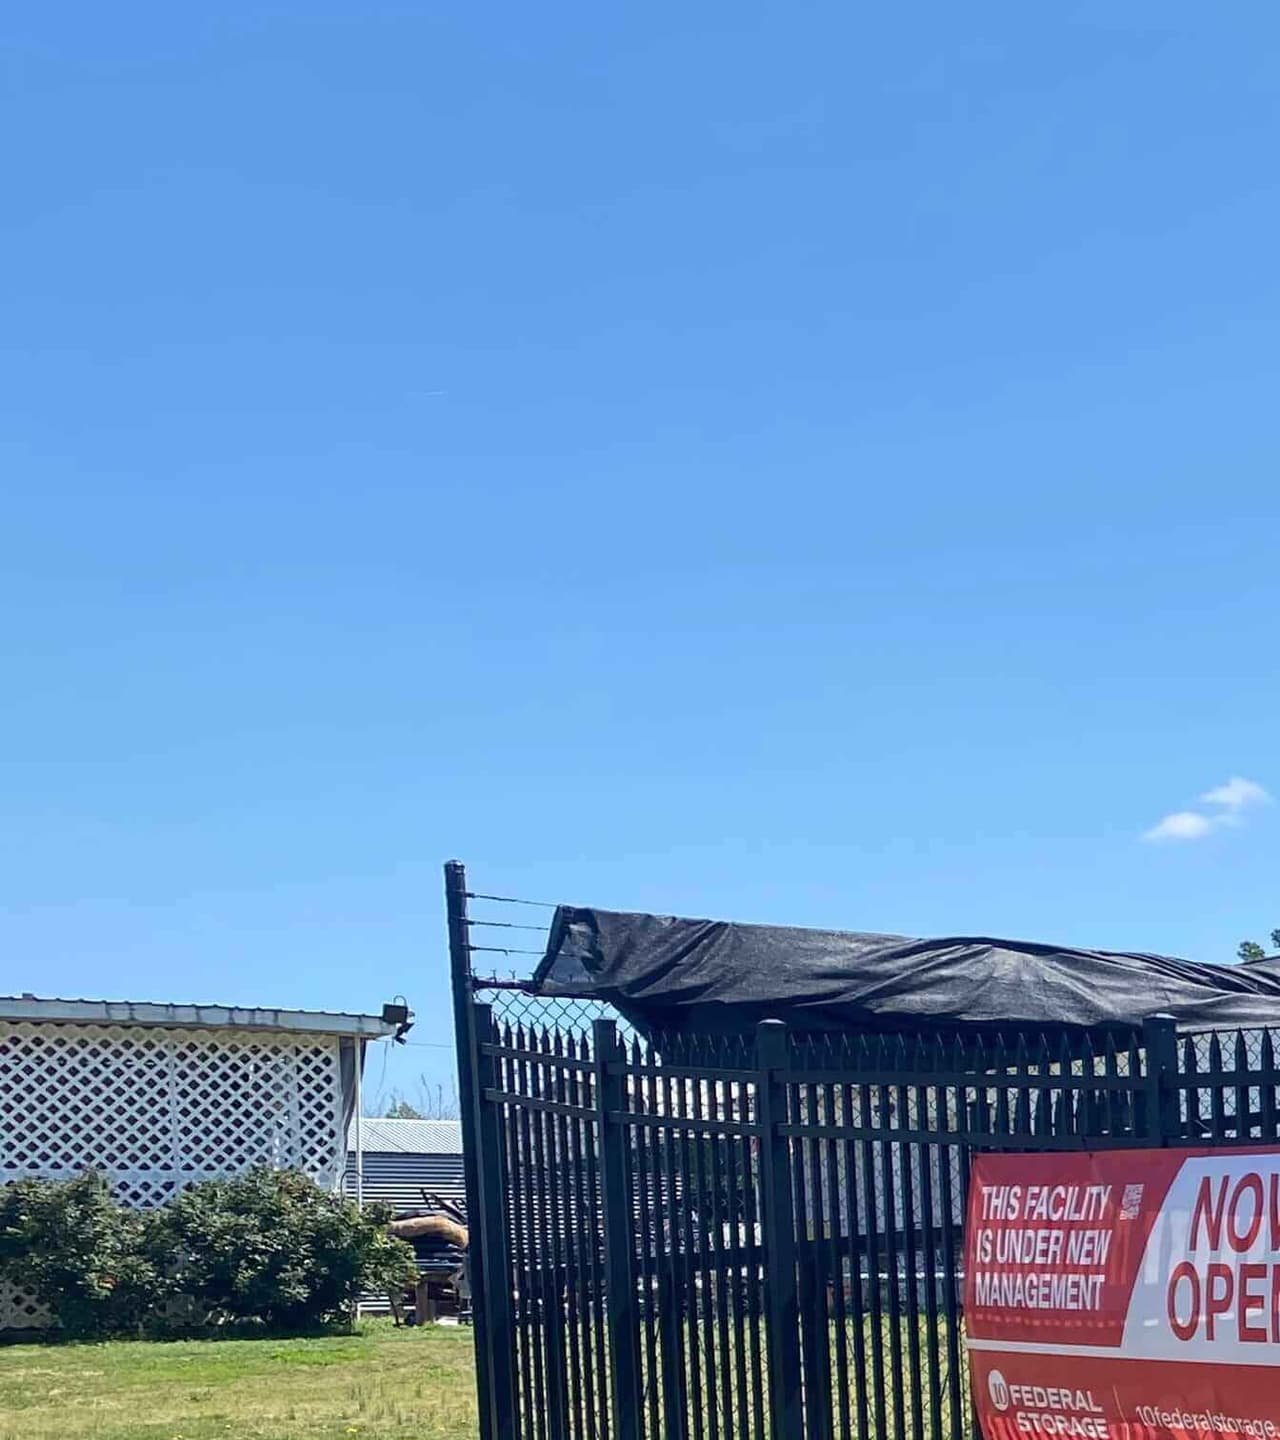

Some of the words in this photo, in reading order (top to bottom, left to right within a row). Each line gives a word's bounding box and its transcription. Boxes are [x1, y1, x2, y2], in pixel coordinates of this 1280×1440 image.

[980, 1186, 1020, 1221] THIS
[1022, 1184, 1112, 1221] FACILITY
[975, 1229, 991, 1264] IS
[996, 1229, 1061, 1265] UNDER
[1066, 1229, 1112, 1266] NEW
[975, 1272, 1105, 1311] MANAGEMENT
[1009, 1384, 1104, 1413] FEDERAL
[1016, 1412, 1108, 1440] STORAGE
